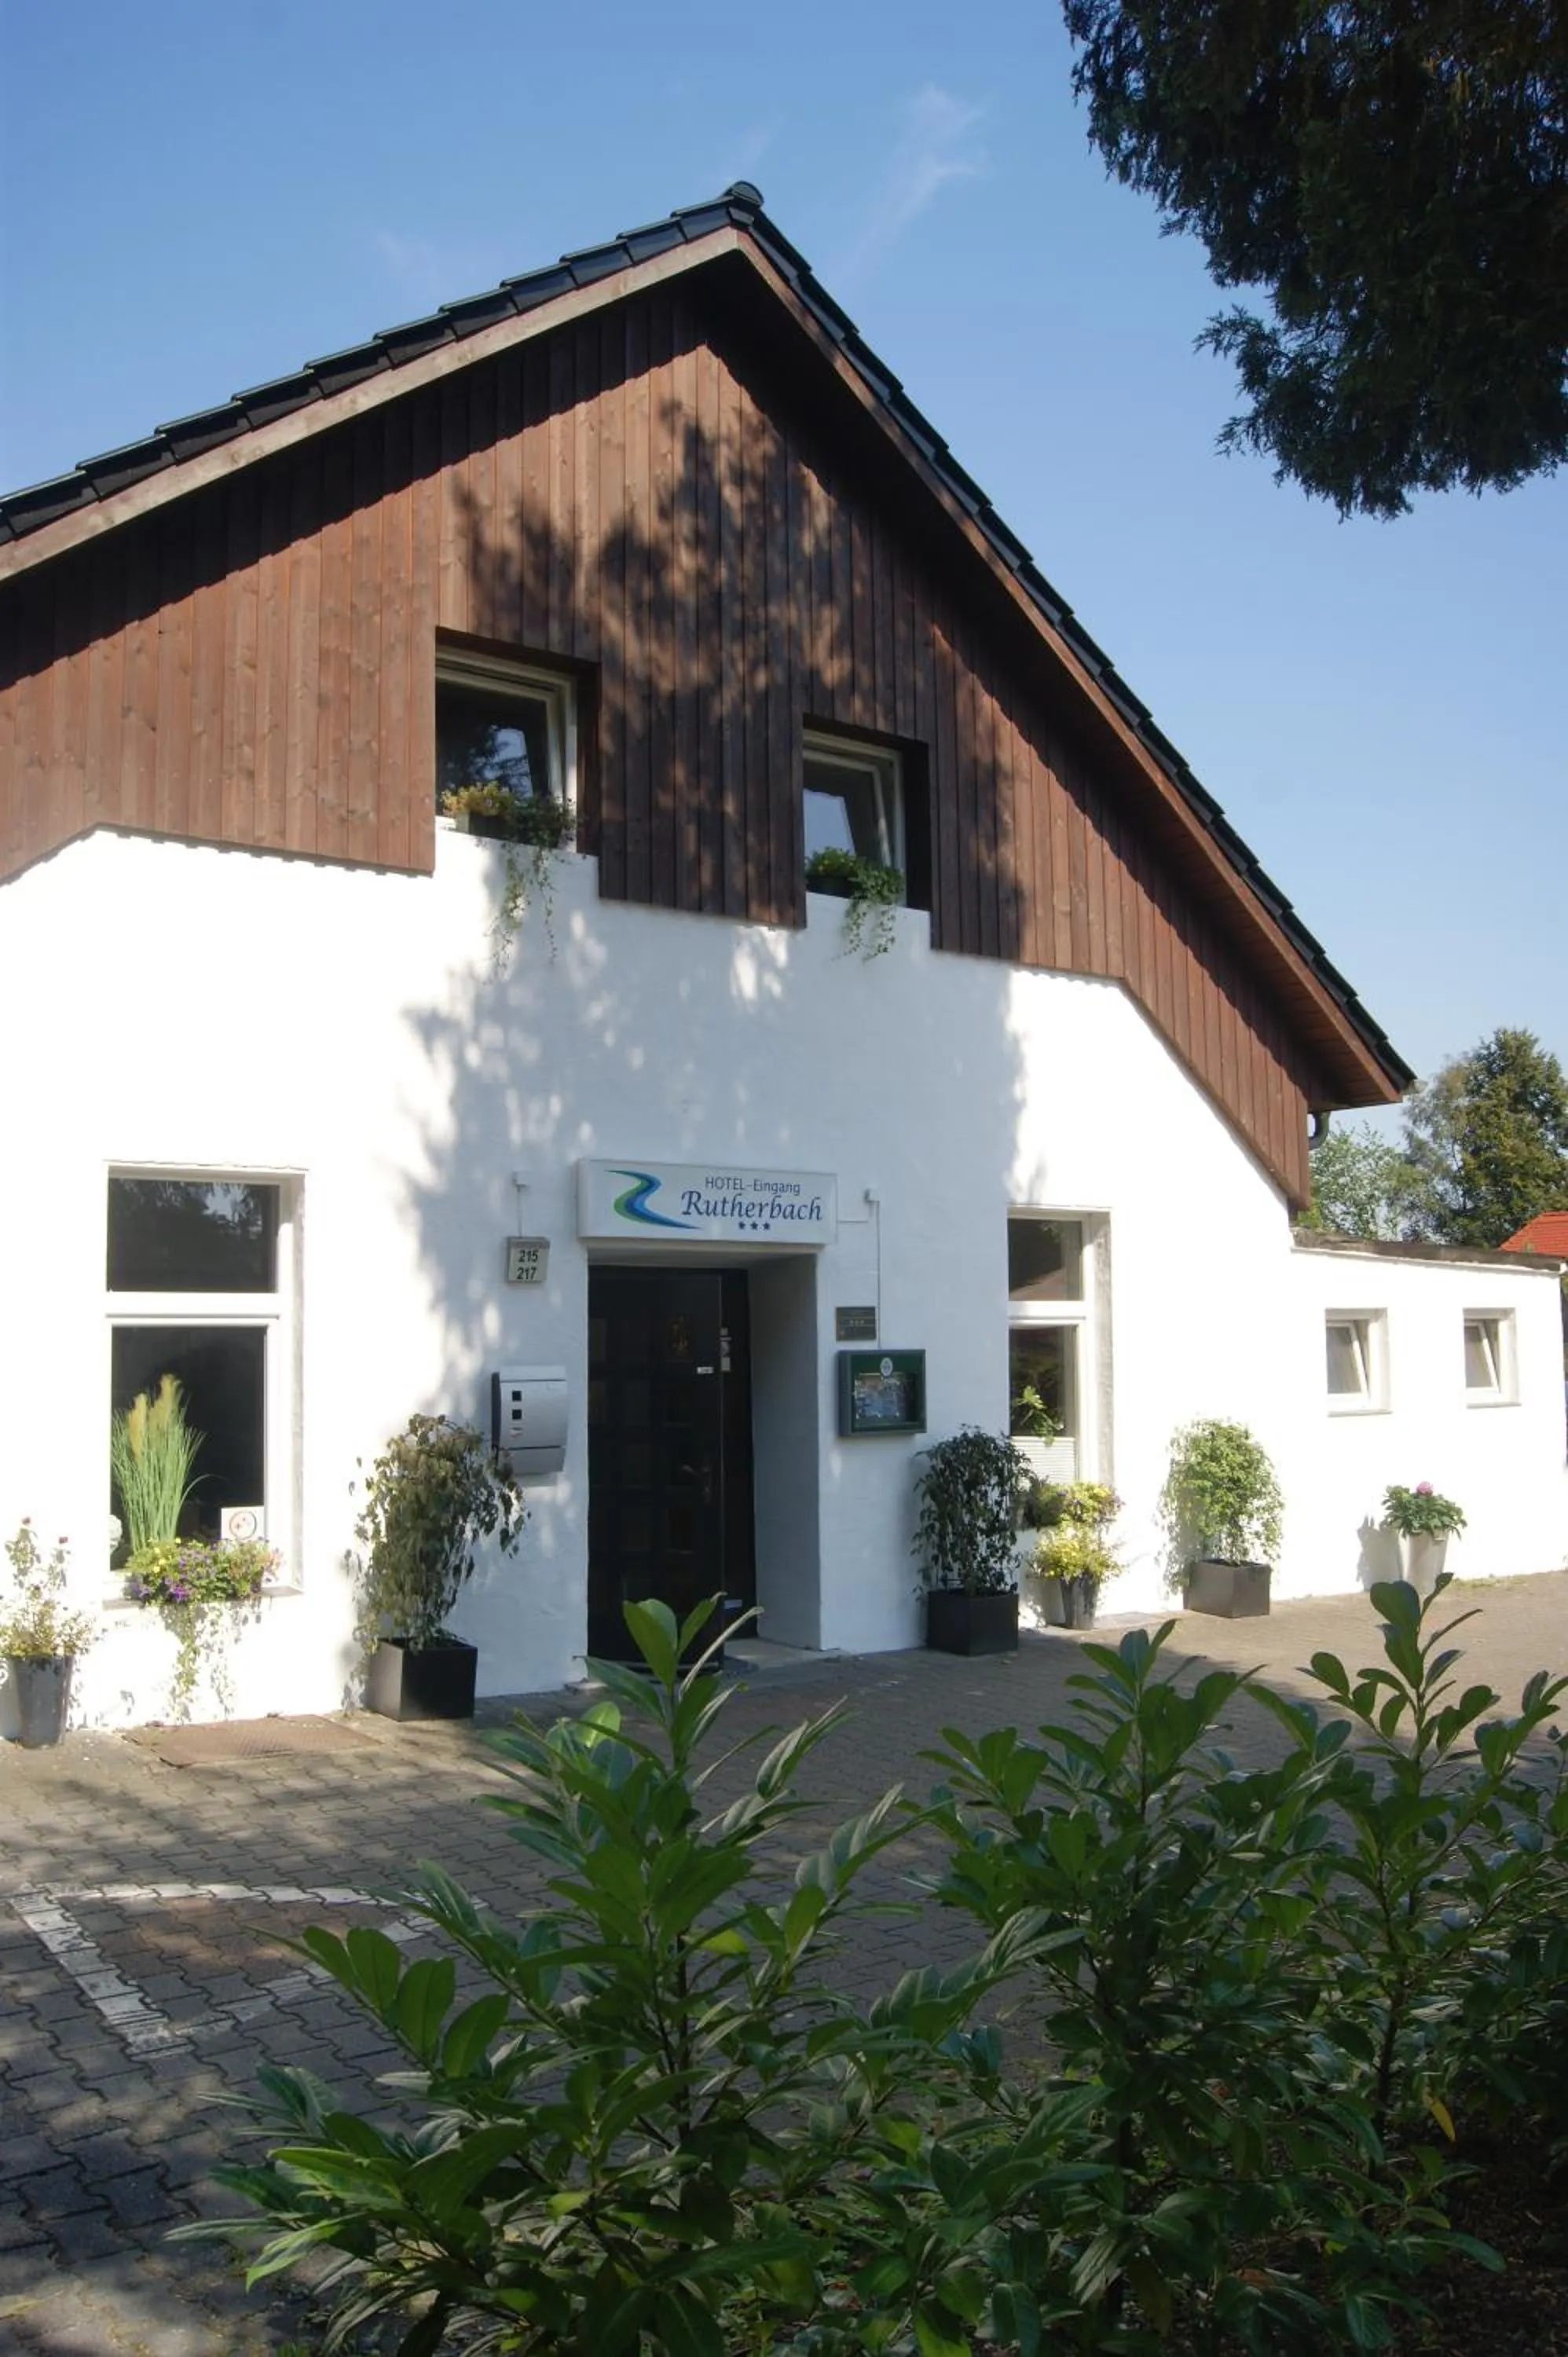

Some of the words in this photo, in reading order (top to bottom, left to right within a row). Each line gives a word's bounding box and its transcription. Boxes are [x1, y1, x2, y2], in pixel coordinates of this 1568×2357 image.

[681, 1190, 822, 1221] Rutherbach
[518, 1249, 538, 1263] 215
[517, 1266, 537, 1280] 217
